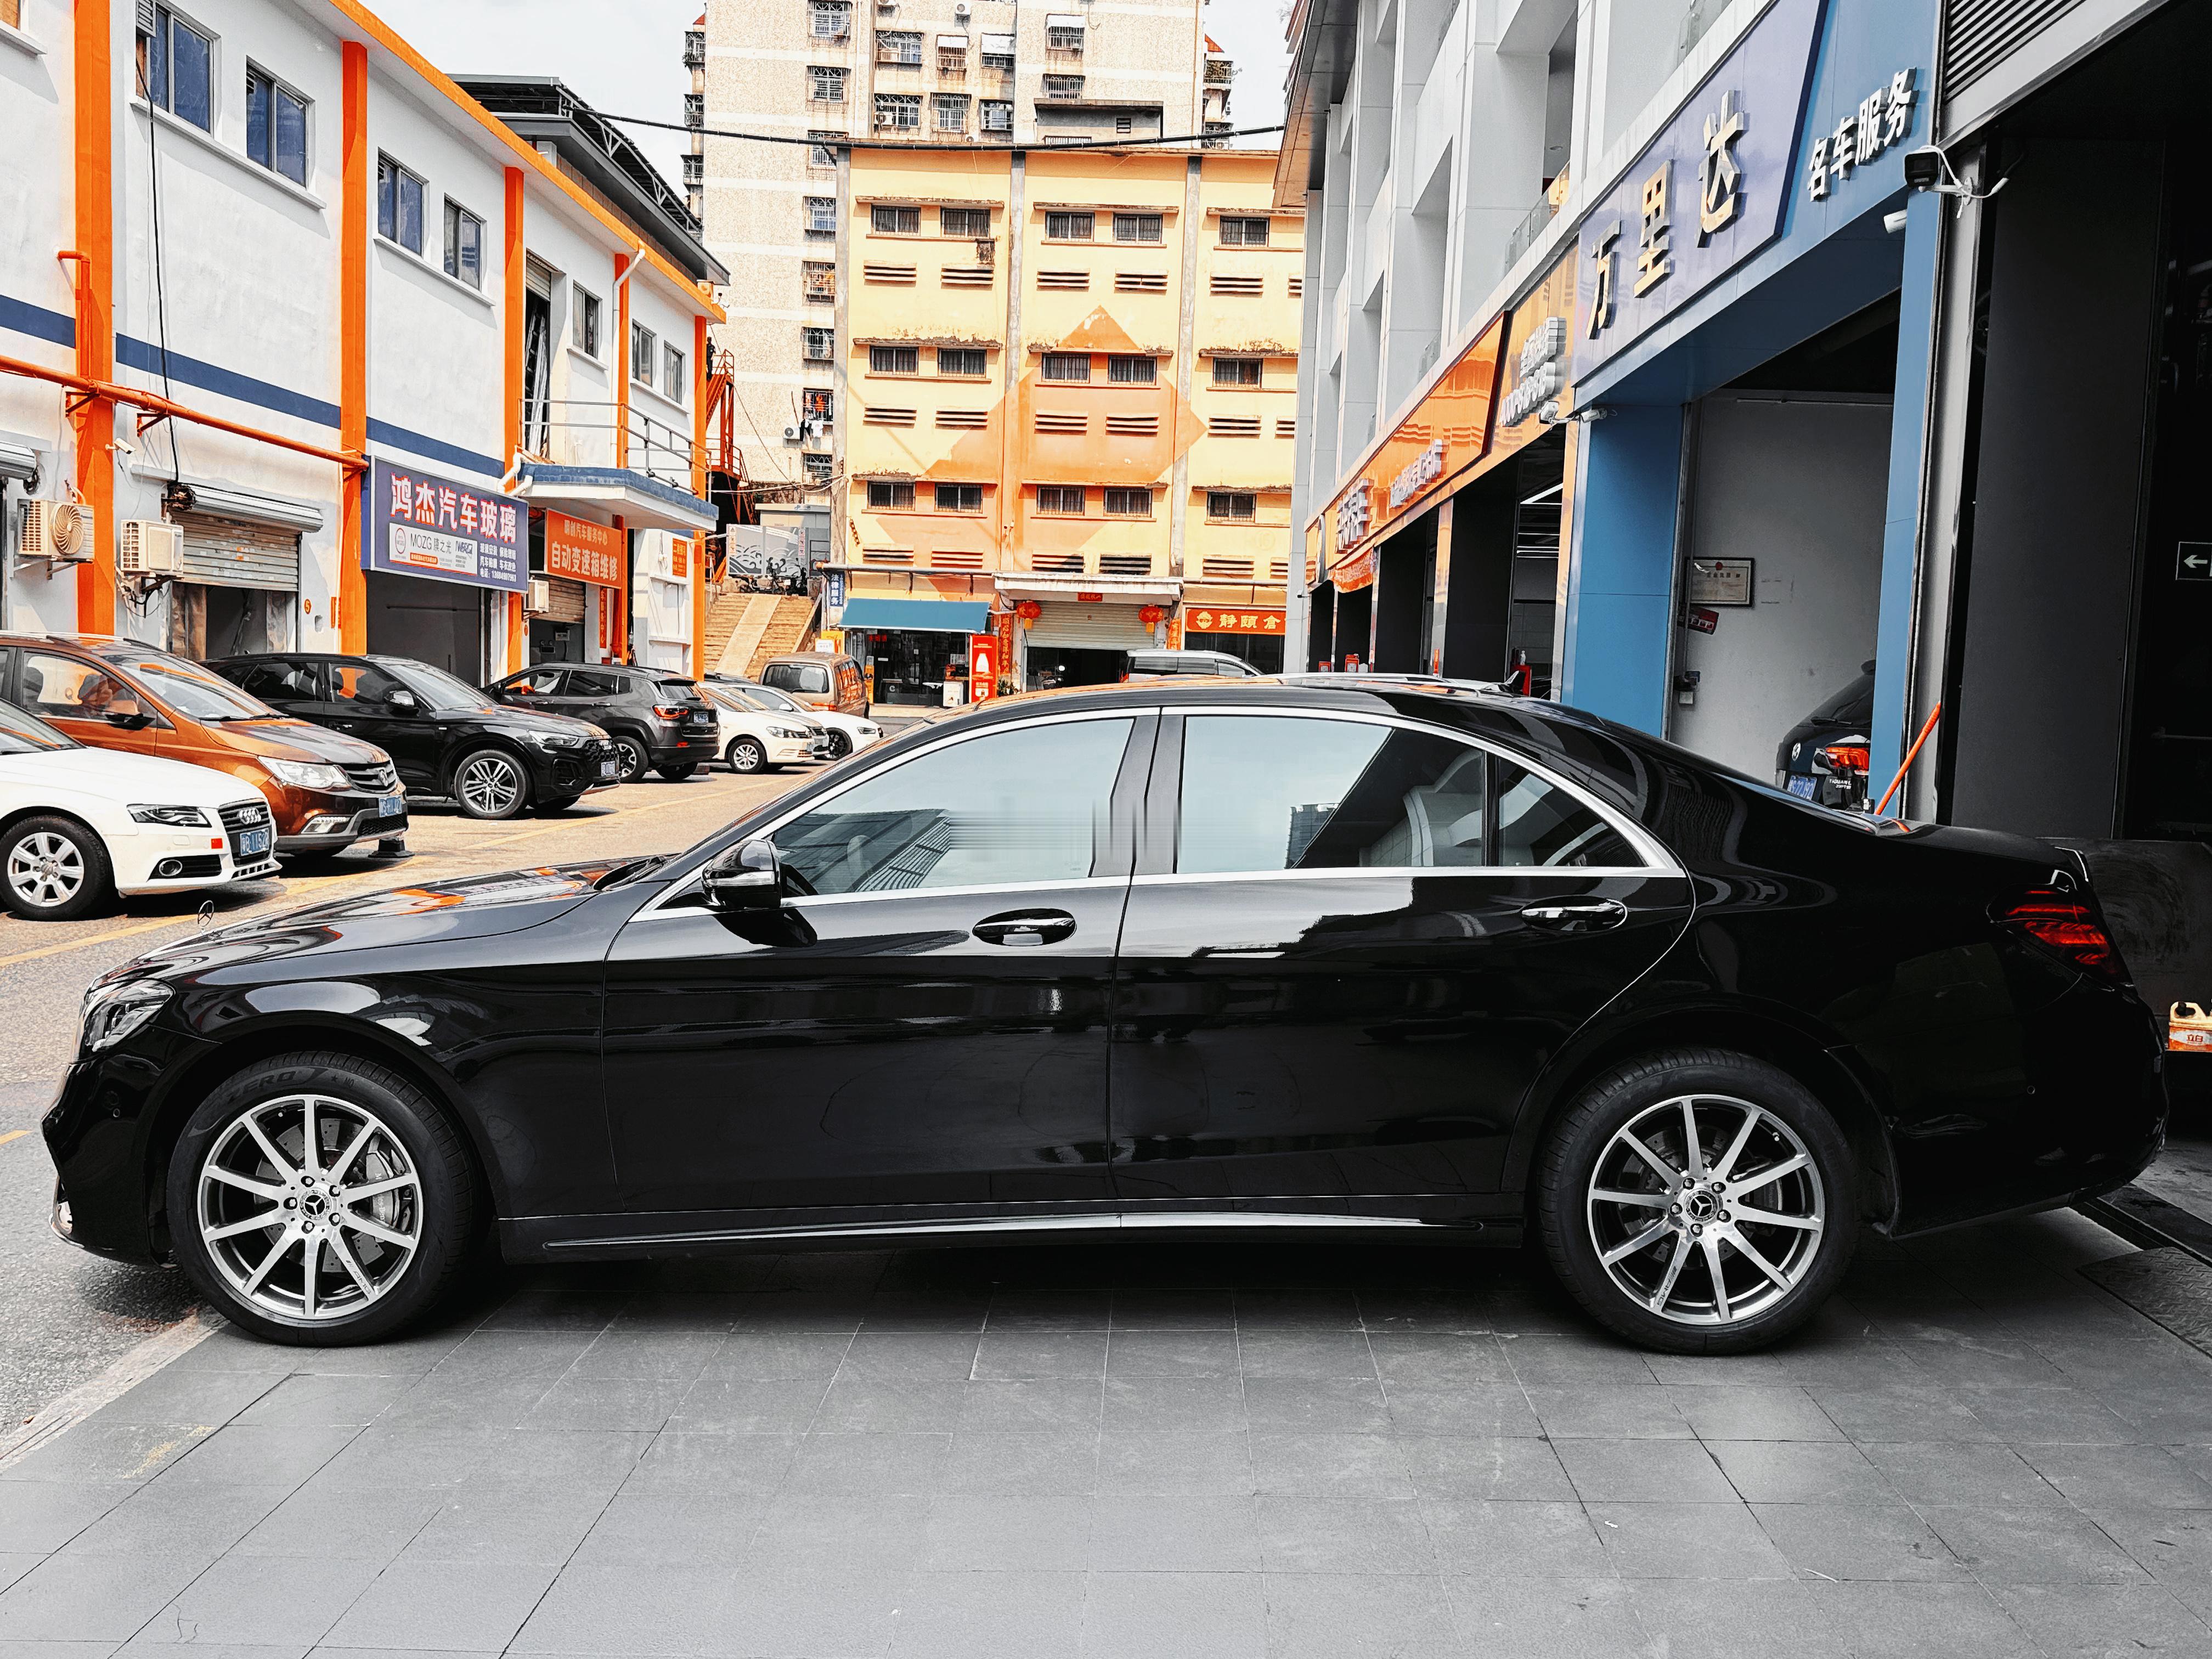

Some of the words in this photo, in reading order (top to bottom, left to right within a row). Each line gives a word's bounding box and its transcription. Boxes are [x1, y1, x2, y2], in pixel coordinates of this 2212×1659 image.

[1808, 66, 1917, 202] 名车服务
[1585, 90, 1746, 340] 万里达
[391, 472, 516, 544] 鸿杰汽车玻璃
[410, 533, 432, 550] MOZG
[551, 540, 617, 581] 自动变速箱维修
[306, 600, 310, 613] 5
[353, 1271, 371, 1295] AMG
[1657, 1279, 1672, 1306] AMG
